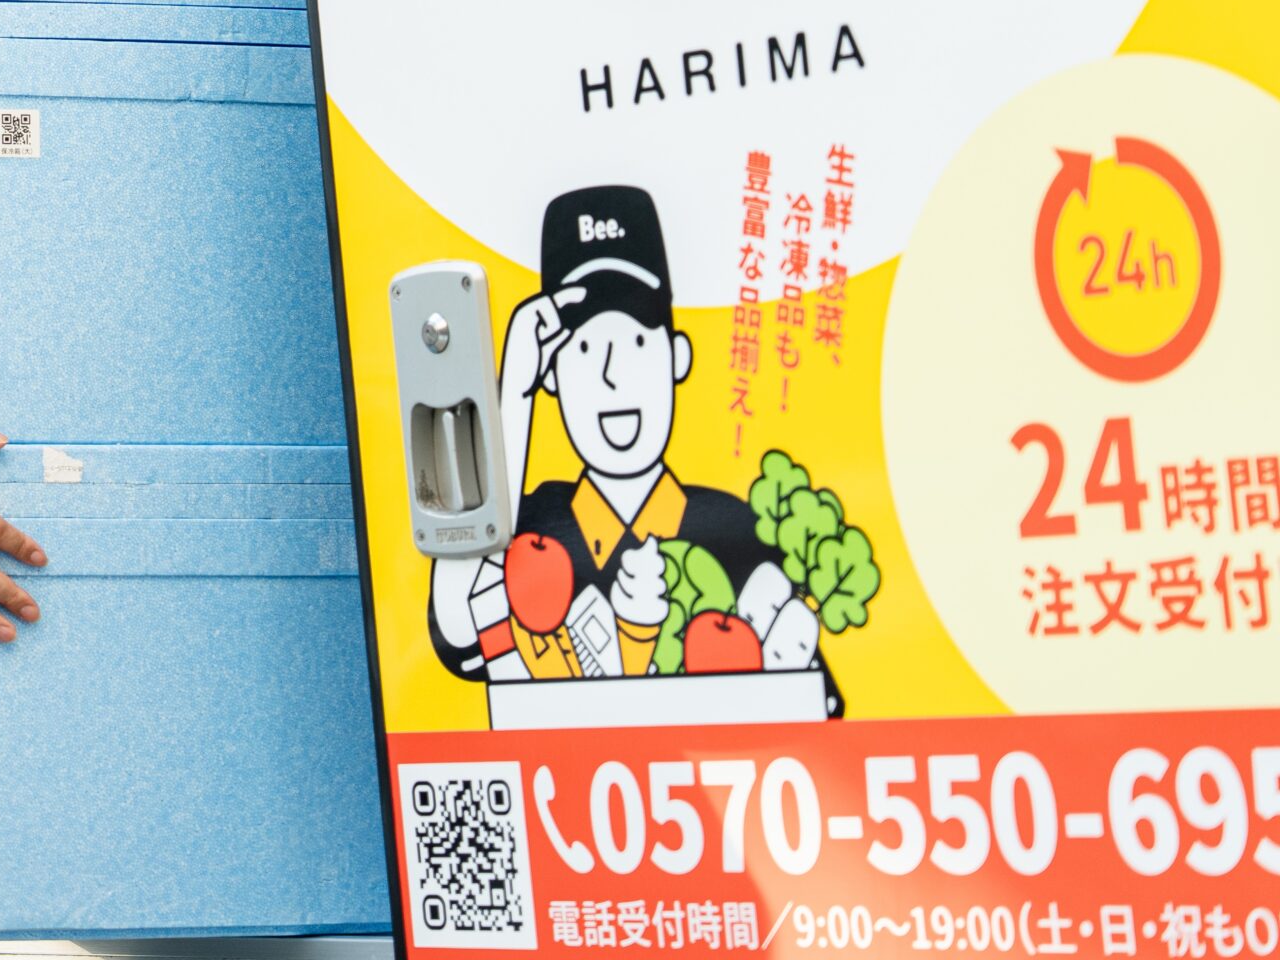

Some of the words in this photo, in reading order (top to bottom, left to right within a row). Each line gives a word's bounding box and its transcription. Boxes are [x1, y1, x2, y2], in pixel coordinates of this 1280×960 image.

[579, 24, 867, 113] HARIMA
[578, 214, 626, 243] Bee.
[1077, 230, 1178, 297] 24h
[1010, 416, 1280, 538] 24時間
